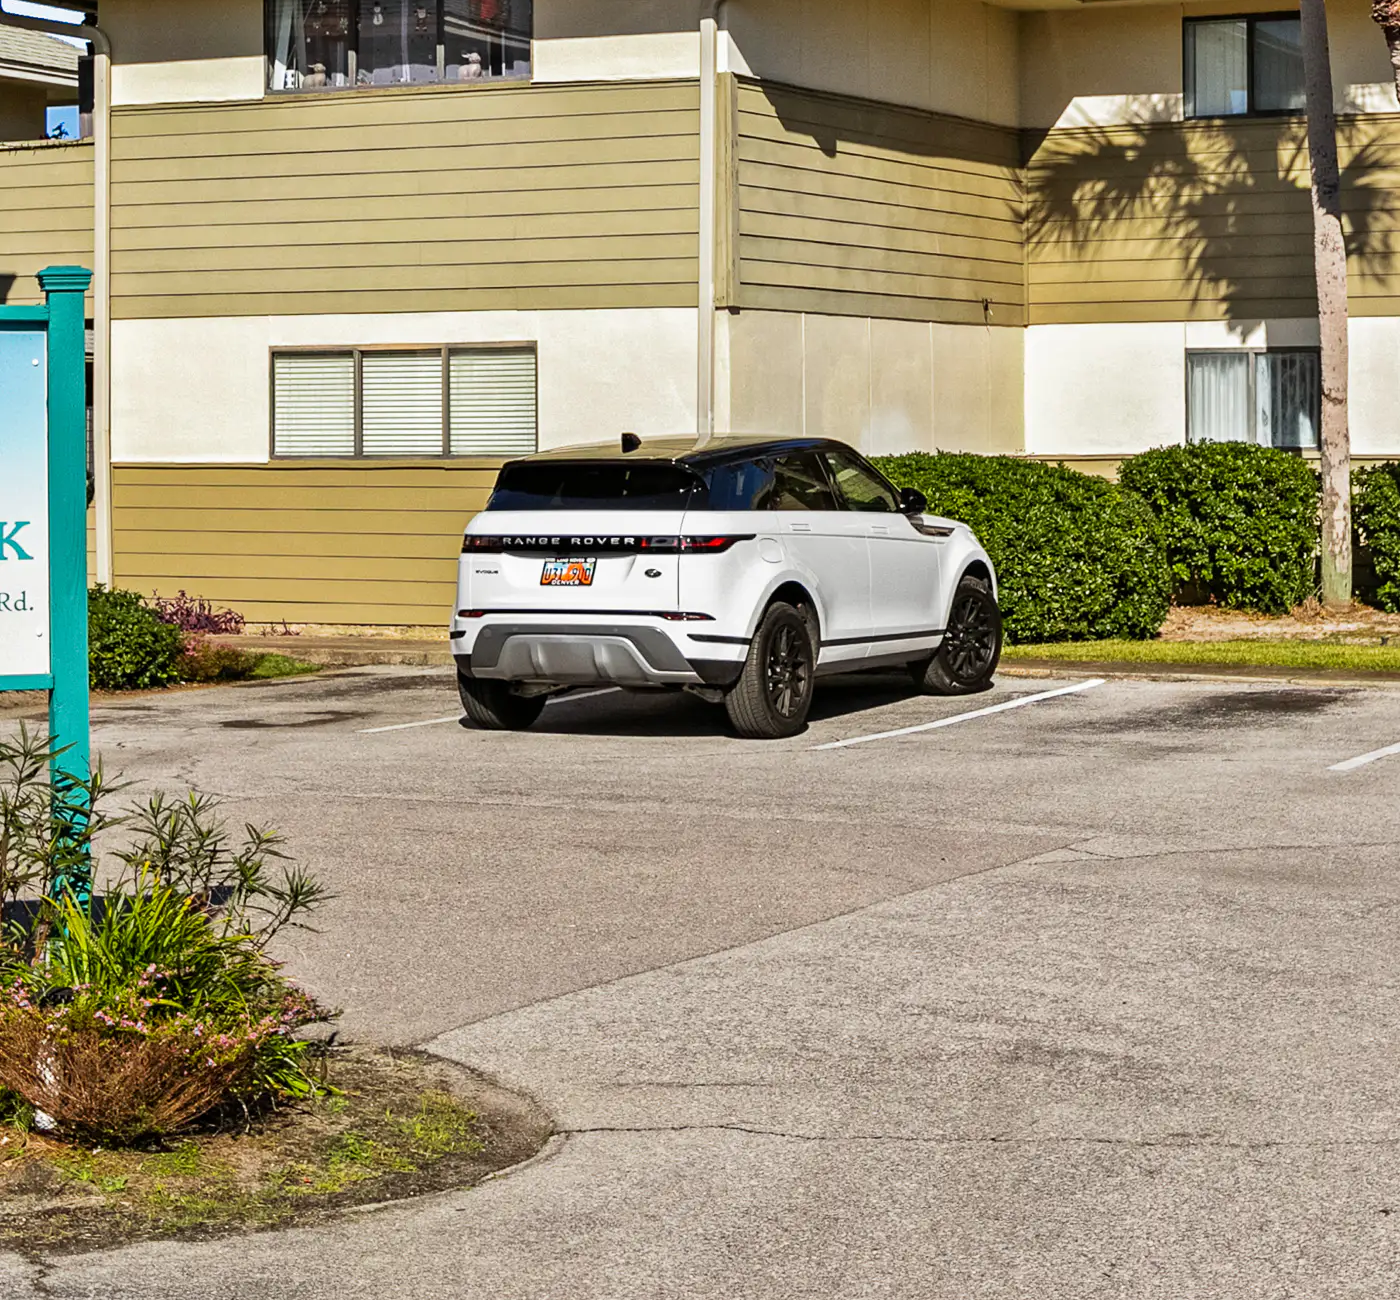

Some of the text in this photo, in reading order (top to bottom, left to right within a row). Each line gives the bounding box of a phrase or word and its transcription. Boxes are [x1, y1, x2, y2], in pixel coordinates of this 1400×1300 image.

[0, 521, 34, 560] K
[502, 537, 635, 545] RANGE ROVER
[0, 591, 34, 611] Rd.
